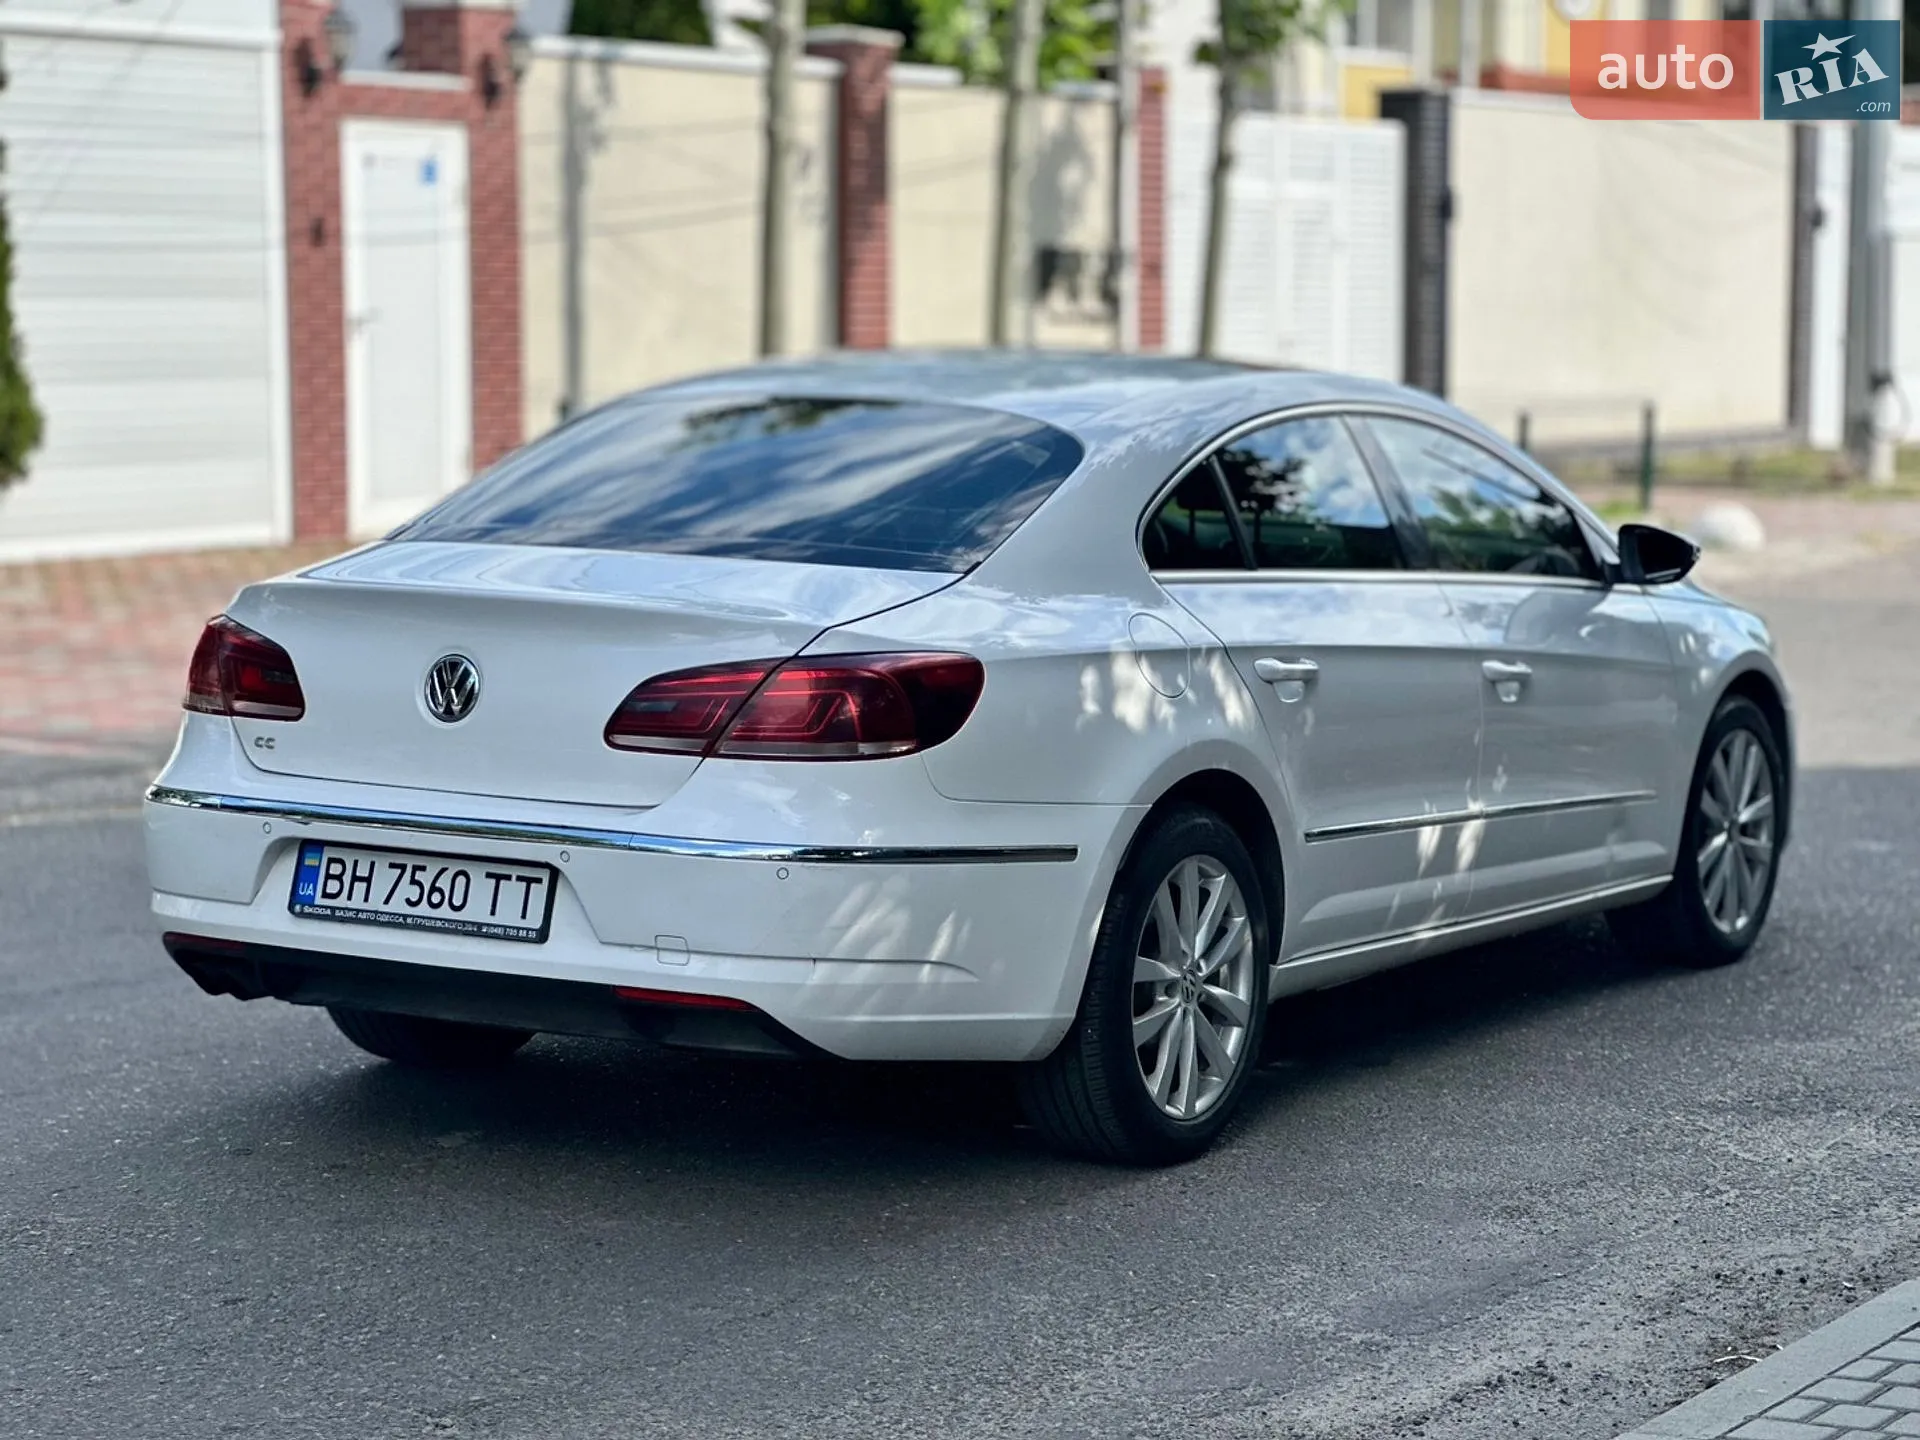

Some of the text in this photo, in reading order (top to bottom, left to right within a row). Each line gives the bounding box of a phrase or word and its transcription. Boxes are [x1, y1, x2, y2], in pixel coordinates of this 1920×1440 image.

[254, 736, 275, 750] CC
[298, 882, 314, 896] UA
[321, 856, 543, 920] BH 7560 TT
